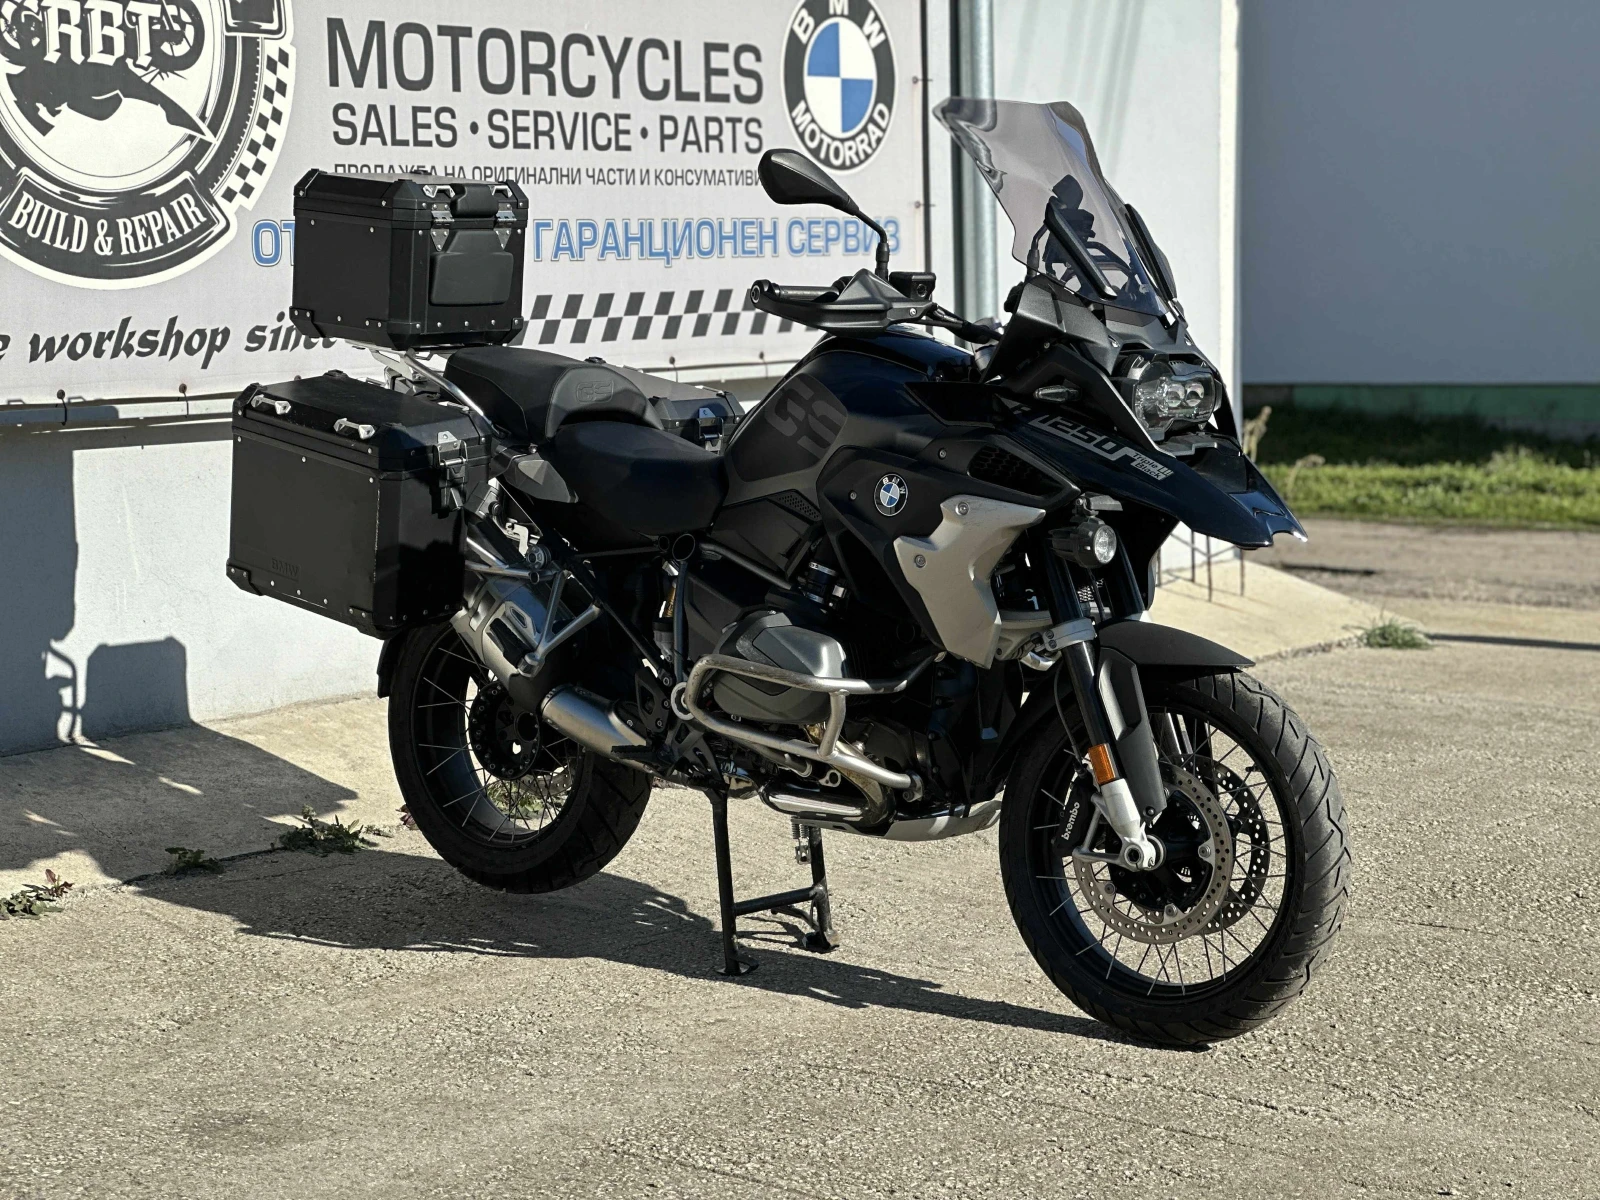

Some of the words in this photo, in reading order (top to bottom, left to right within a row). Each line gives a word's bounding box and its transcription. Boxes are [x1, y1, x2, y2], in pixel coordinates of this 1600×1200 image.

[792, 0, 886, 48] BMW
[326, 17, 763, 104] MOTORCYCLES
[332, 102, 458, 149] SALES
[487, 108, 632, 152] SERVICE
[659, 115, 763, 154] PARTS
[791, 101, 890, 167] MOTORRAD
[472, 165, 581, 185] ОРИГИНАЛНИ
[586, 167, 635, 186] ЧАСТИ
[640, 168, 650, 186] И
[8, 190, 88, 254] BUILD
[93, 217, 114, 256] &
[116, 192, 207, 256] REPAIR
[533, 218, 778, 268] ГАРАНЦИОНЕН
[29, 315, 231, 370] workshop
[882, 476, 906, 494] BMW
[1132, 452, 1159, 469] Triple
[1134, 462, 1161, 479] Black
[1060, 801, 1080, 841] brembo
